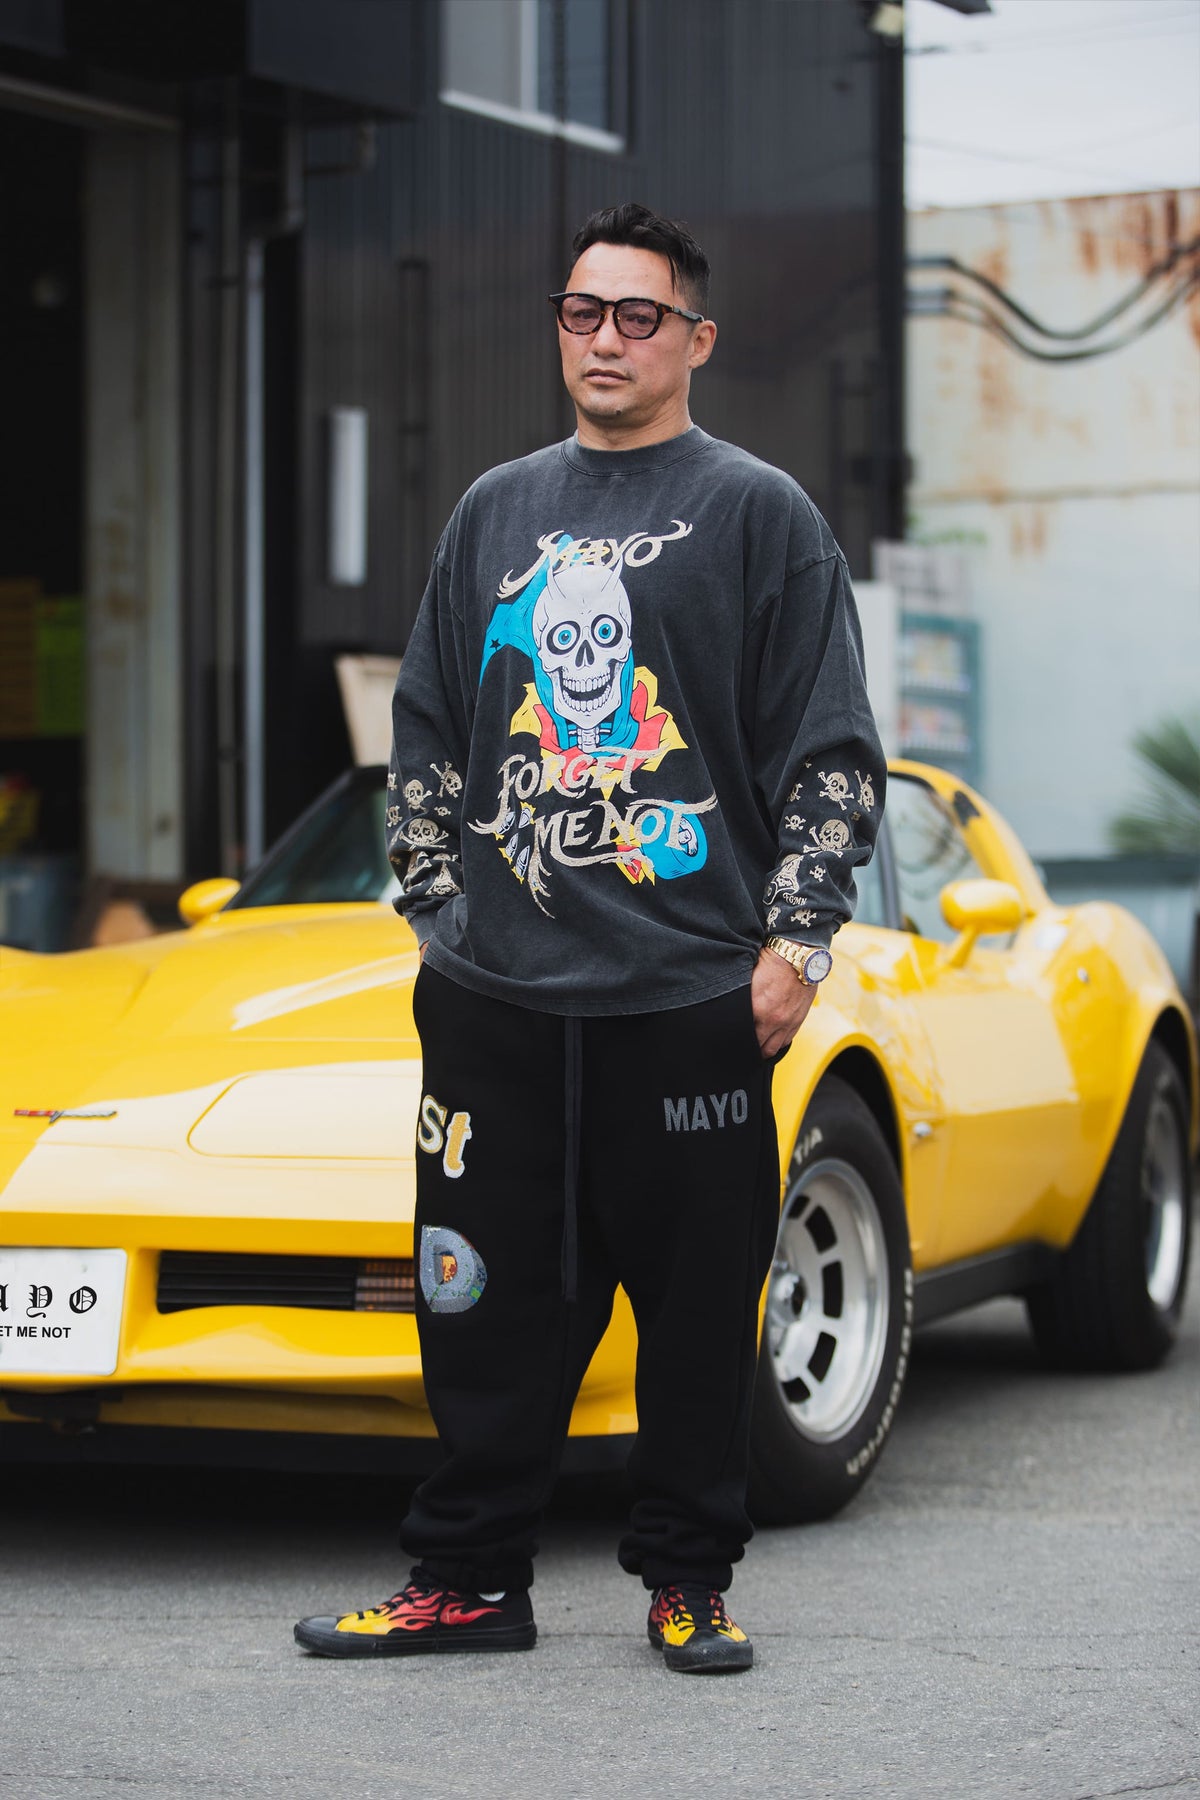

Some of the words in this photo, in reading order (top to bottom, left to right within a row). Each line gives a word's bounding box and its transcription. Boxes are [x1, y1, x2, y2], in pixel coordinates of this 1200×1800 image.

[496, 519, 693, 599] MAYO
[467, 743, 671, 835] FORGET
[590, 792, 718, 851] NOT
[527, 809, 655, 919] ME
[663, 1088, 748, 1132] MAYO
[16, 1326, 38, 1338] ME
[41, 1326, 72, 1339] NOT
